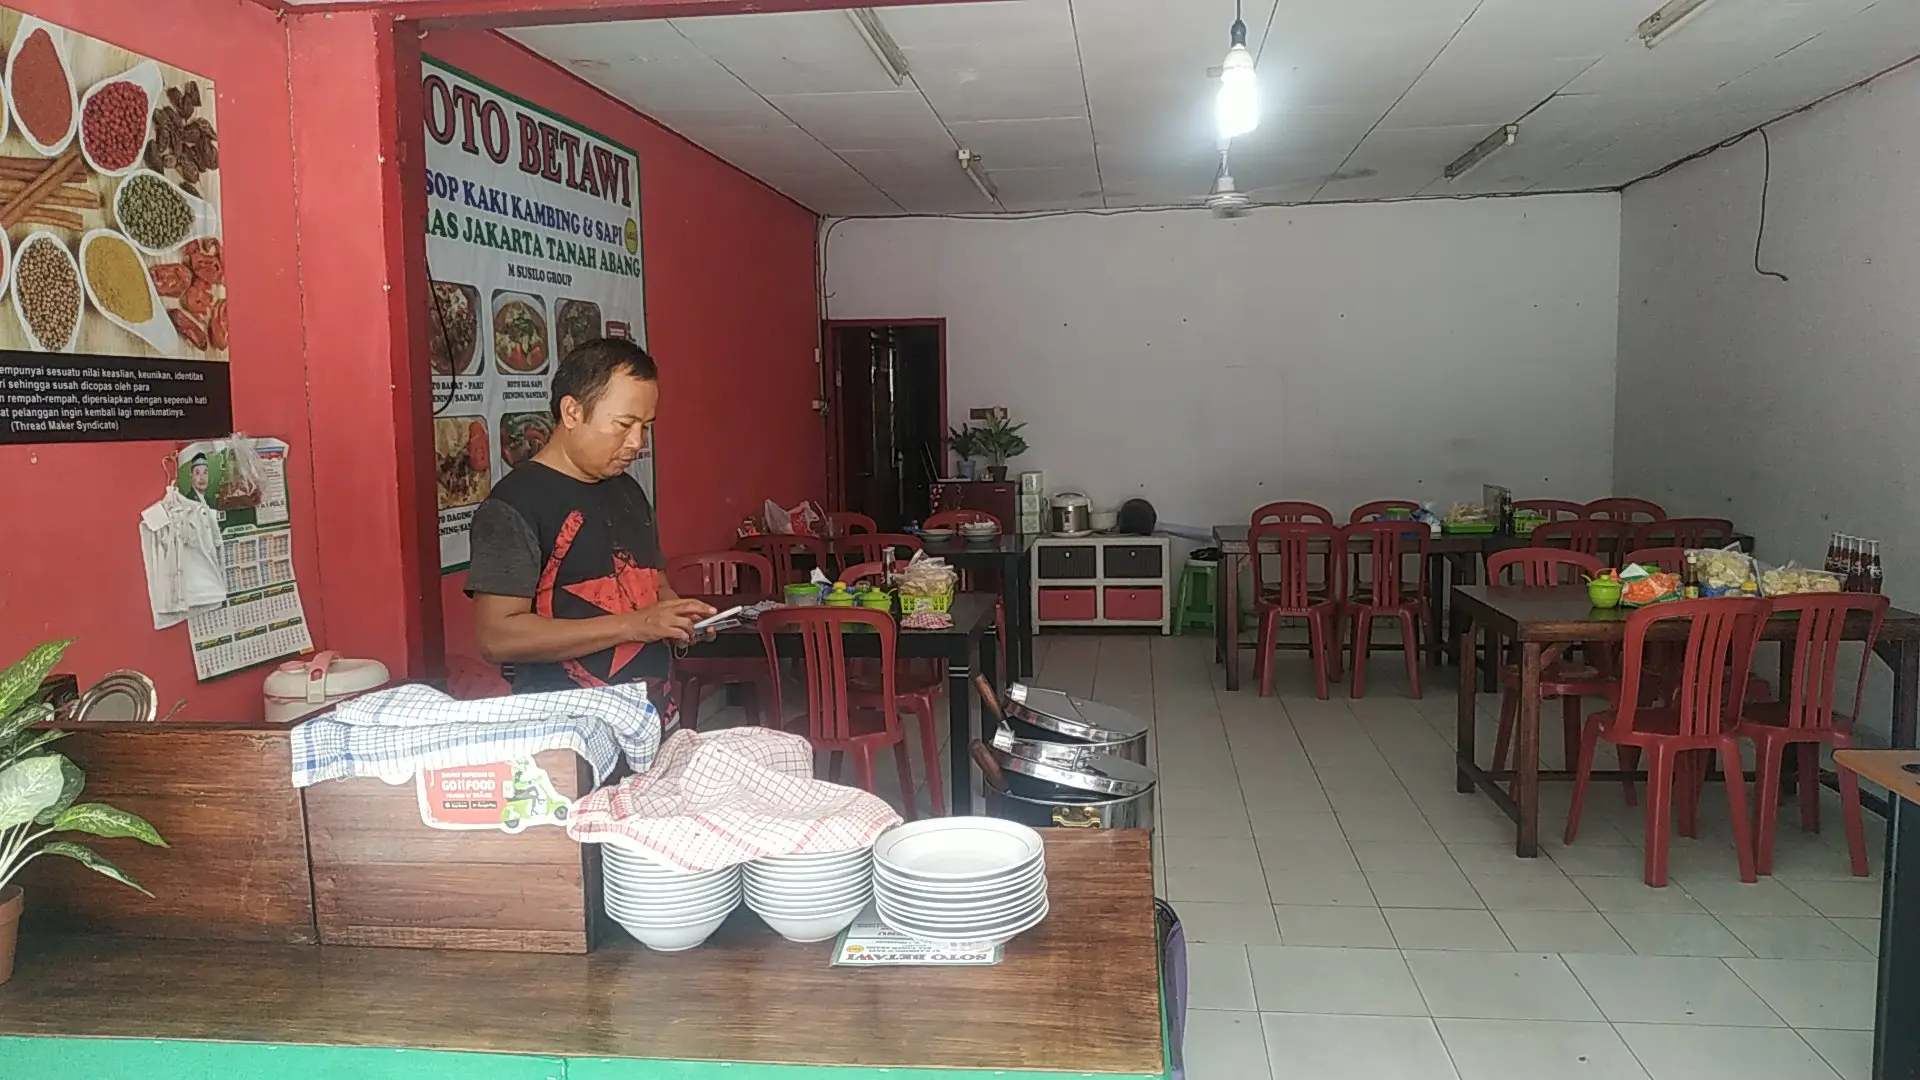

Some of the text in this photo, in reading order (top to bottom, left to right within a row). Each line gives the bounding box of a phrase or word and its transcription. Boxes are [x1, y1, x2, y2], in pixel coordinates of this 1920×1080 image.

[422, 74, 632, 208] OTO BETAWI
[425, 169, 623, 247] SOP KAKI KAMBING & SAPI
[462, 216, 546, 259] JAKARTA
[546, 239, 598, 270] TANAH
[600, 251, 640, 279] ABANG
[517, 266, 546, 282] SUSILO
[546, 272, 573, 287] GROUP
[46, 367, 80, 377] sesuatu
[82, 368, 100, 377] nilai
[102, 368, 137, 379] keaslian,
[174, 371, 204, 381] identitas
[8, 379, 50, 392] sehingga
[53, 380, 79, 390] susah
[81, 380, 113, 392] dicopas
[114, 382, 131, 391] oleh
[133, 384, 150, 392] para
[7, 394, 81, 405] rempah-rempah,
[82, 394, 133, 406] dipersiapkan
[134, 395, 162, 406] dengan
[163, 396, 193, 406] sepenuh
[194, 395, 208, 405] hati
[12, 408, 59, 419] pelanggan
[61, 407, 83, 419] ingin
[84, 407, 116, 417] kembali
[117, 407, 132, 418] lagi
[10, 420, 119, 433] (Thread Maker Syndicate)
[465, 779, 496, 791] FOOD
[846, 953, 988, 961] SOTO BETAWI
